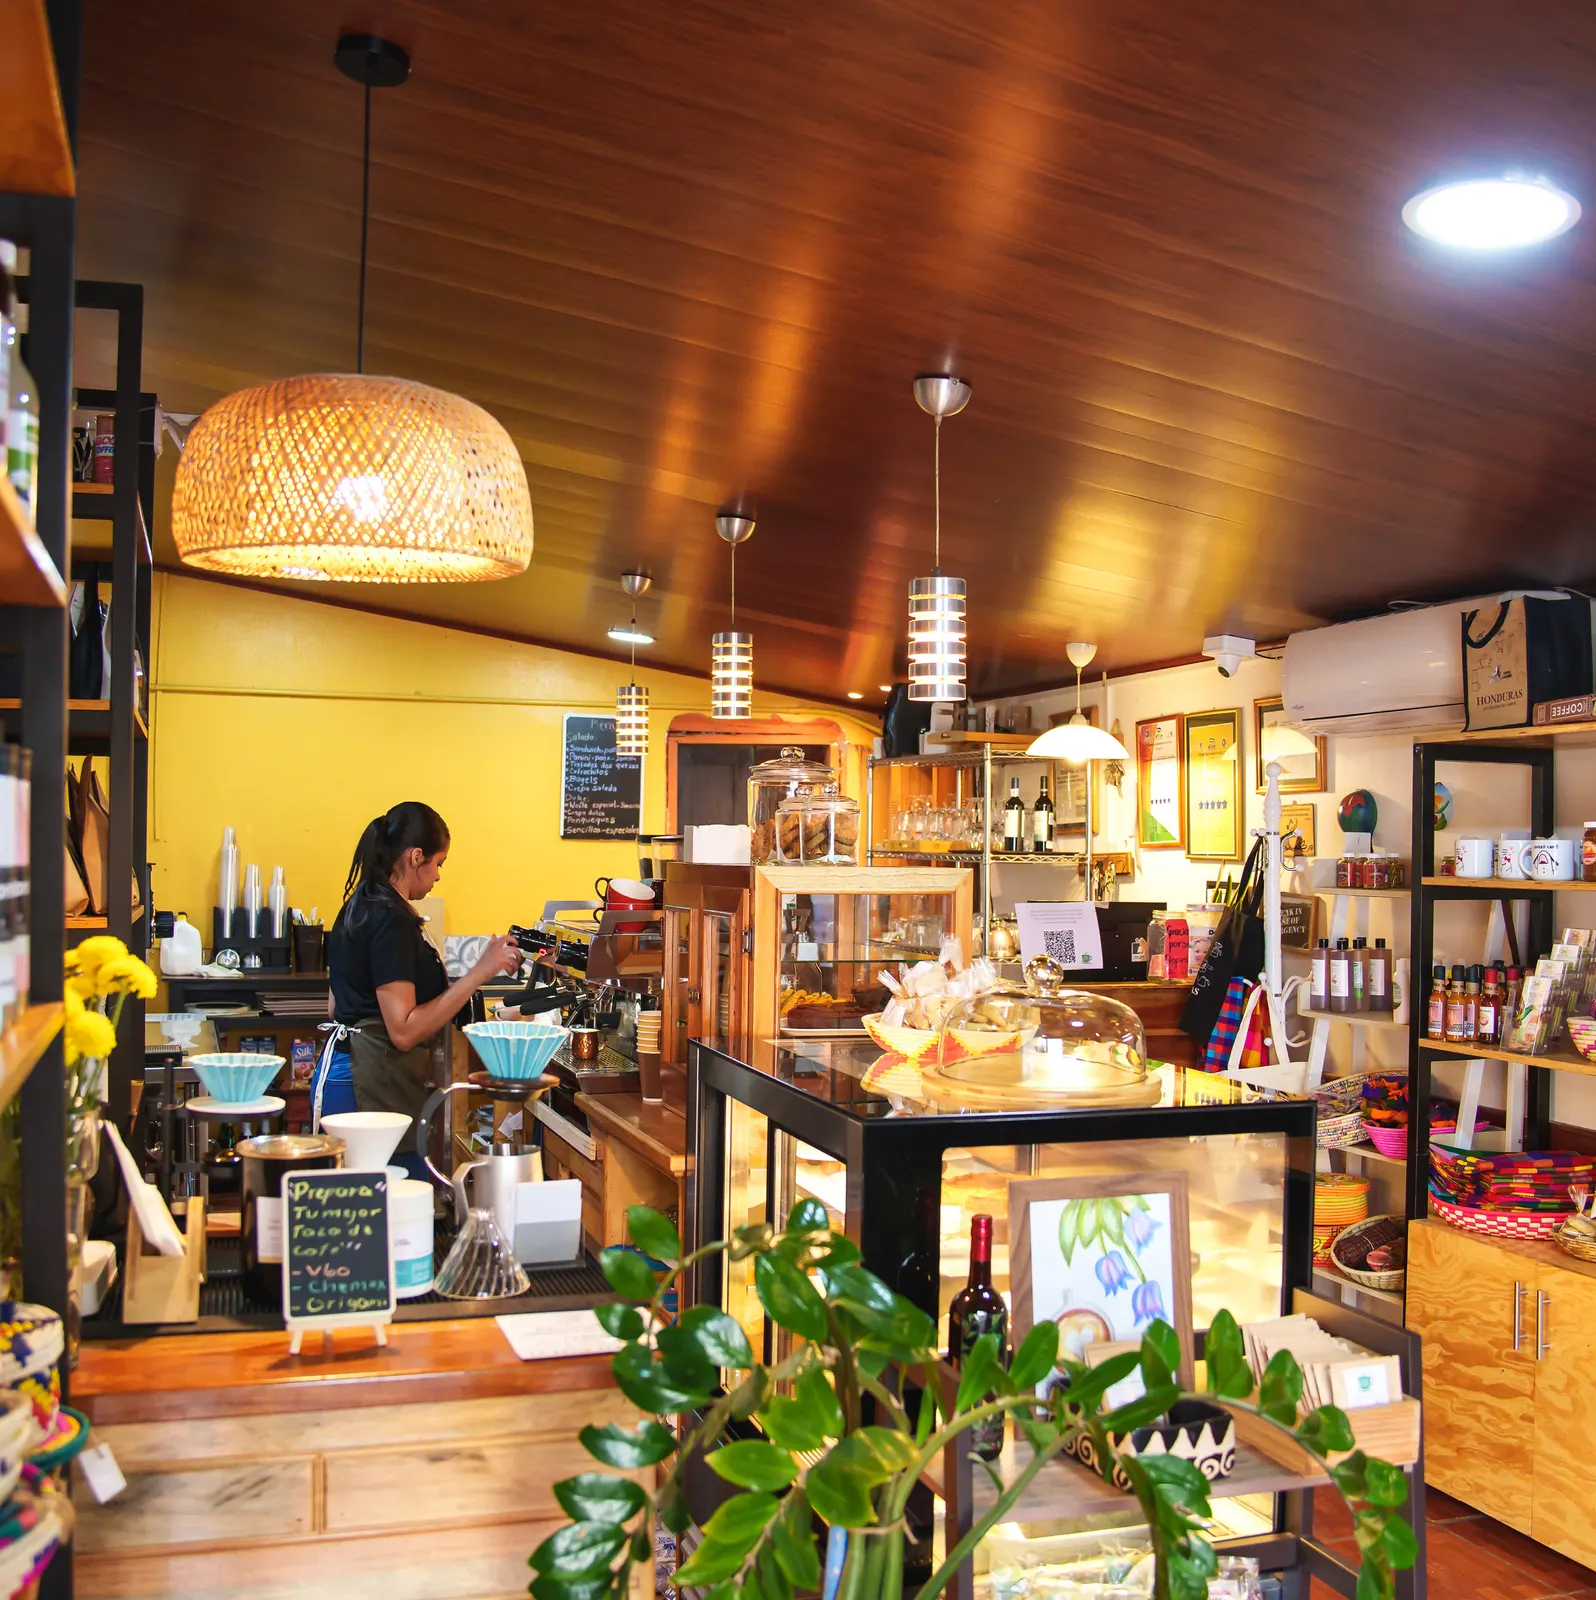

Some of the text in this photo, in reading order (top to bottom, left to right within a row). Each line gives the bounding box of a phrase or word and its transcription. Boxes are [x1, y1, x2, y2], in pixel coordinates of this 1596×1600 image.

[1476, 688, 1523, 706] HONDURAS
[1551, 702, 1583, 717] COFFEE
[567, 775, 599, 786] Bagels
[567, 816, 616, 825] Panqueques
[295, 1046, 312, 1058] Silk
[322, 1207, 382, 1225] mejor
